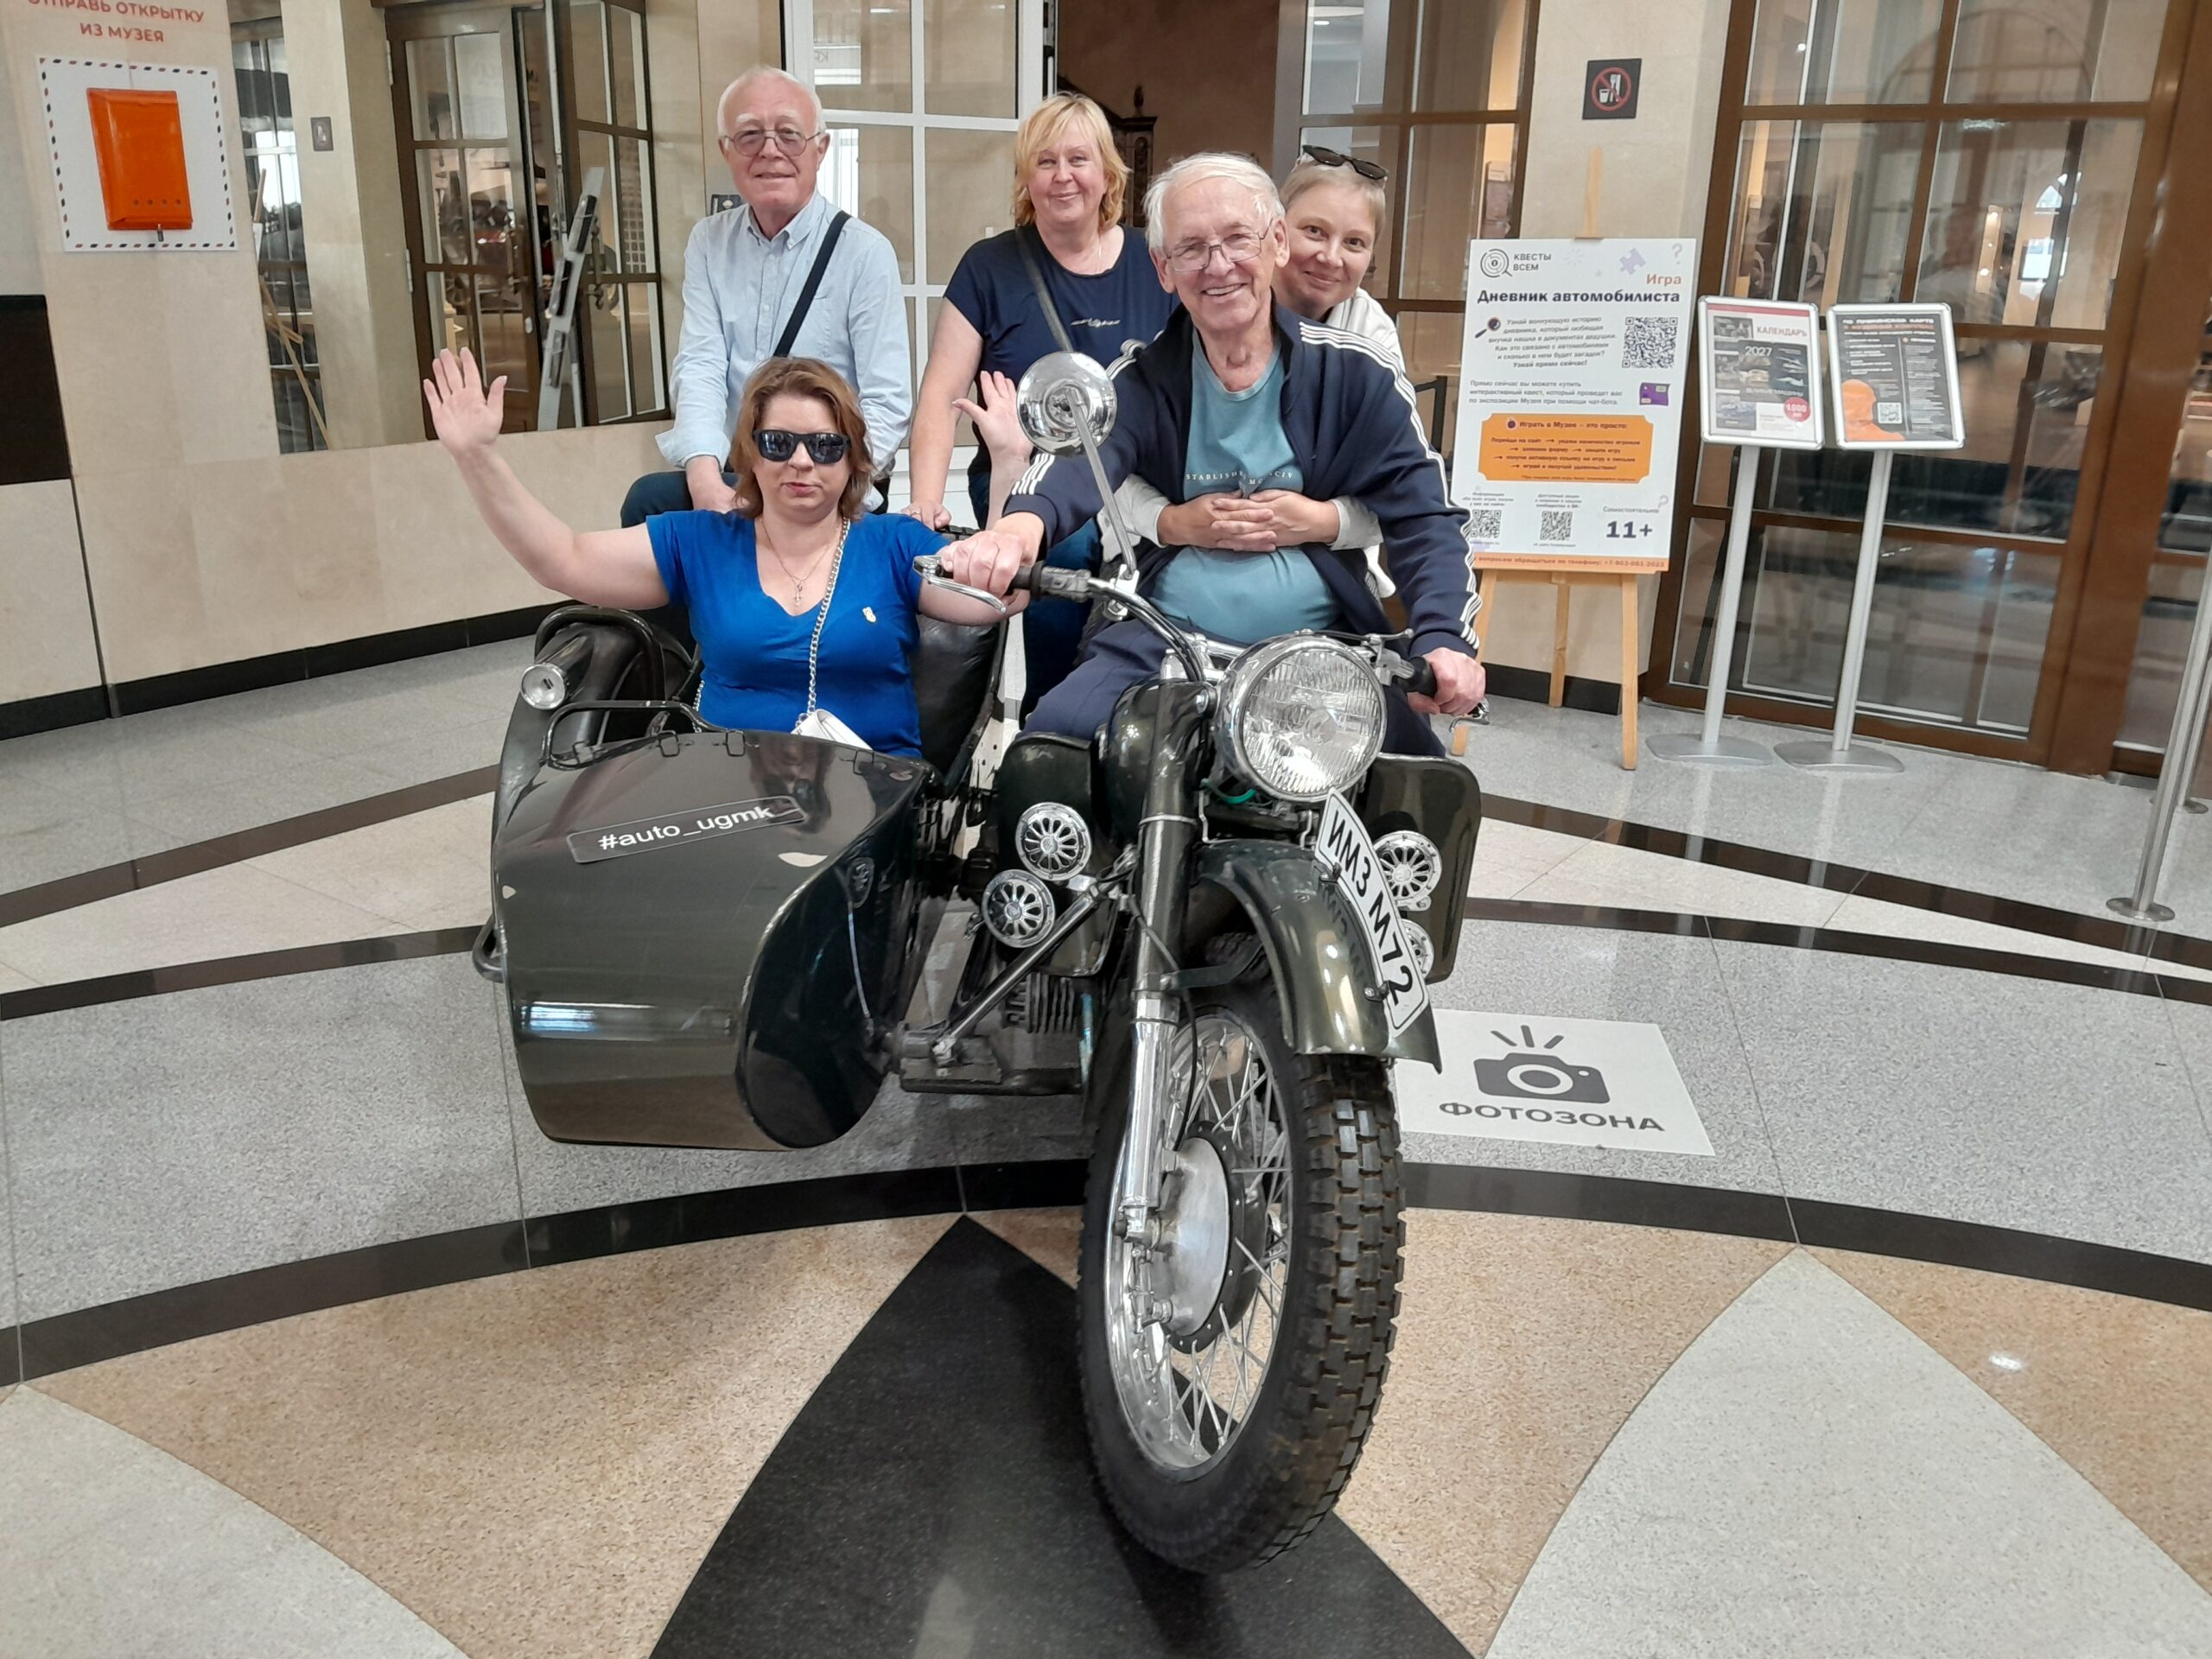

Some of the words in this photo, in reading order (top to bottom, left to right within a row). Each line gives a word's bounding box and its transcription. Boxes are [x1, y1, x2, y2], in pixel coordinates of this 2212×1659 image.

[116, 2, 204, 22] ОТКРЫТКУ
[79, 22, 103, 36] ИЗ
[108, 26, 164, 42] МУЗЕЯ
[1646, 274, 1681, 286] Игра
[1477, 289, 1548, 303] Дневник
[1552, 289, 1680, 302] автомобилиста
[1185, 470, 1247, 481] STABLISHE
[1606, 520, 1653, 538] 11+
[597, 805, 776, 850] #auto_ugmk
[1327, 810, 1371, 897] ИМЗ
[1369, 890, 1414, 1007] М72
[1439, 1103, 1666, 1132] ФОТОЗОНА
